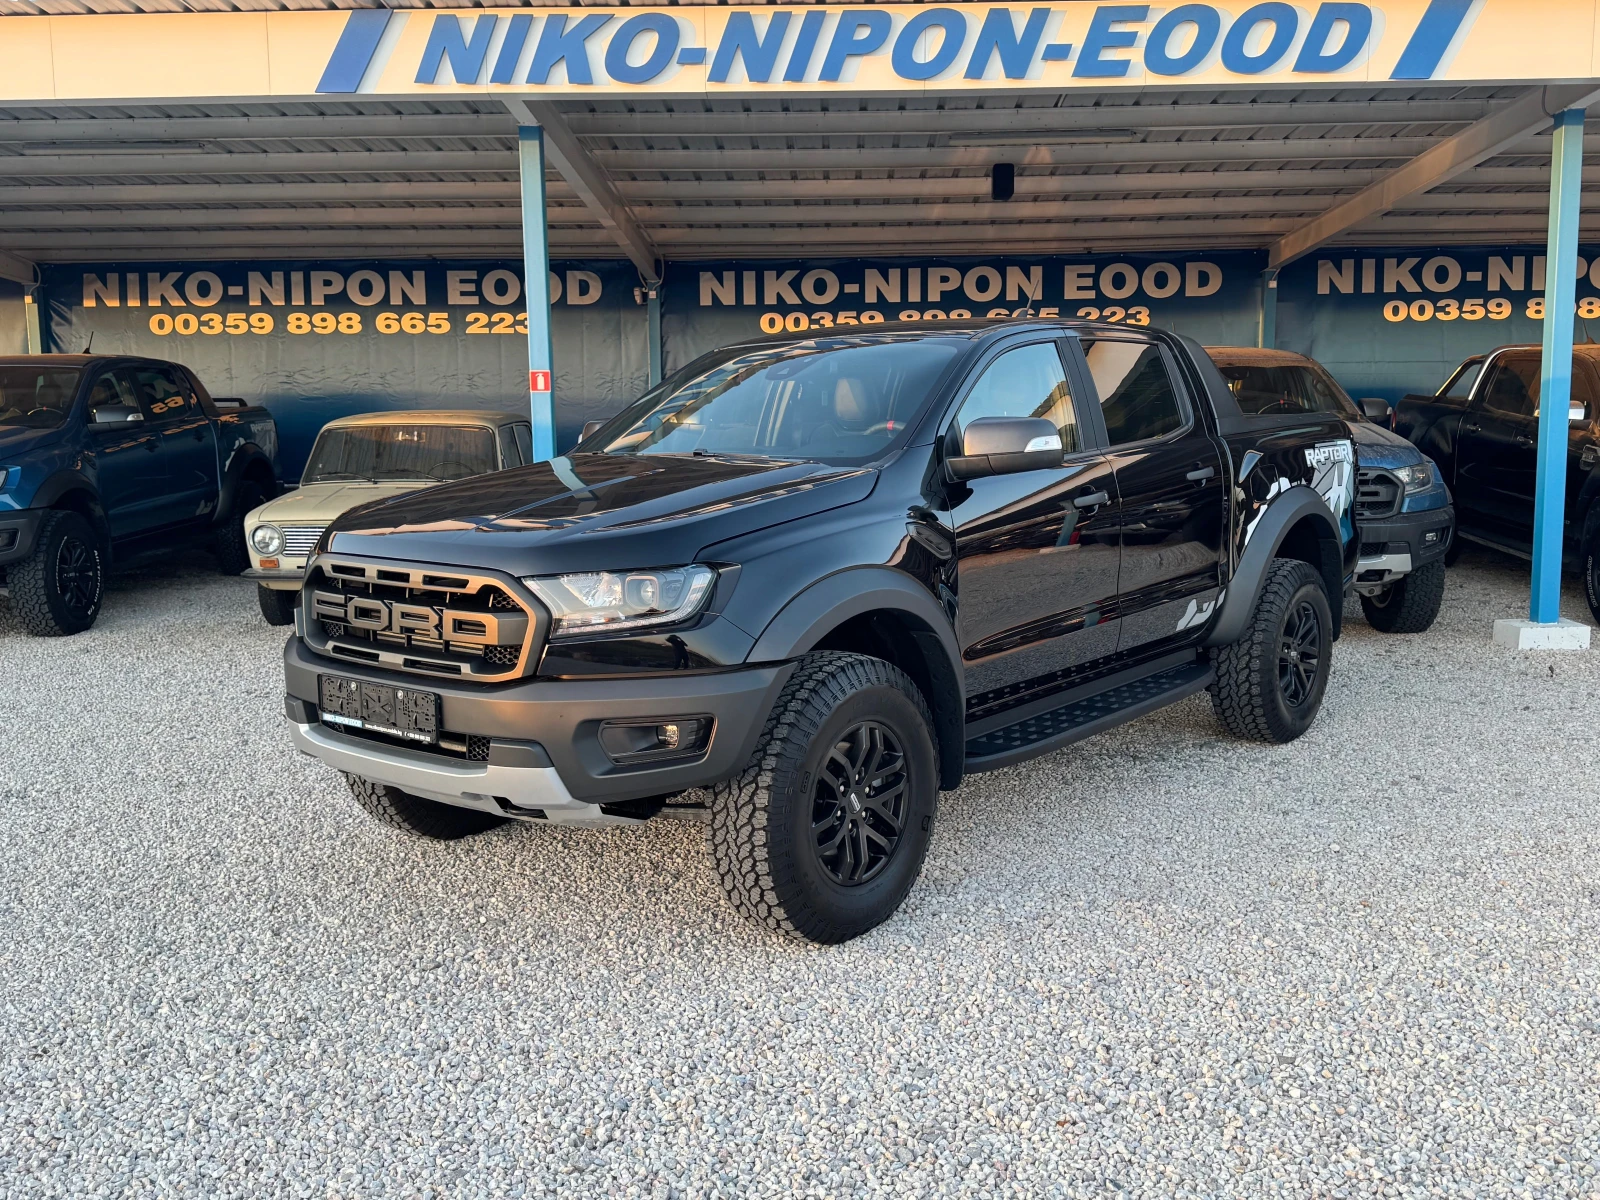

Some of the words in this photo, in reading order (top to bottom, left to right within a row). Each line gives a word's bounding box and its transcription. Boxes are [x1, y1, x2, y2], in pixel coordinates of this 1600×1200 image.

[414, 2, 1373, 85] NIKO-NIPON-EOOD
[82, 270, 427, 307] NIKO-NIPON
[699, 266, 1043, 306] NIKO-NIPON
[1064, 261, 1223, 300] EOOD
[1317, 255, 1600, 295] NIKO-NI
[149, 312, 274, 335] 00359
[286, 312, 363, 335] 898
[375, 311, 451, 334] 665
[1383, 298, 1512, 322] 00359
[1525, 296, 1600, 320] 88
[1304, 445, 1352, 471] RAPTOR
[312, 590, 499, 646] FORD
